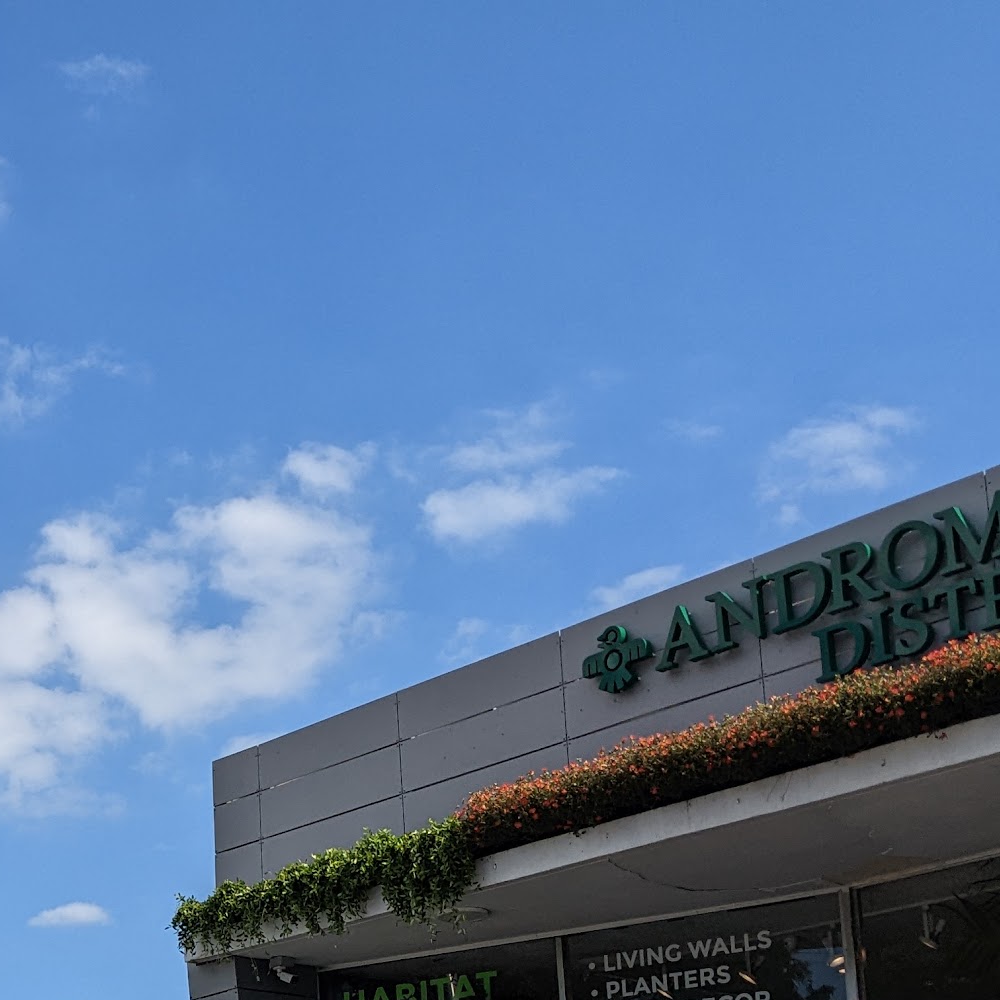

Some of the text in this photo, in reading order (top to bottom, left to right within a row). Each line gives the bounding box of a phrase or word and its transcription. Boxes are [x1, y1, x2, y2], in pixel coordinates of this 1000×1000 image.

[603, 929, 773, 973] LIVING WALLS
[605, 964, 732, 1000] PLANTERS
